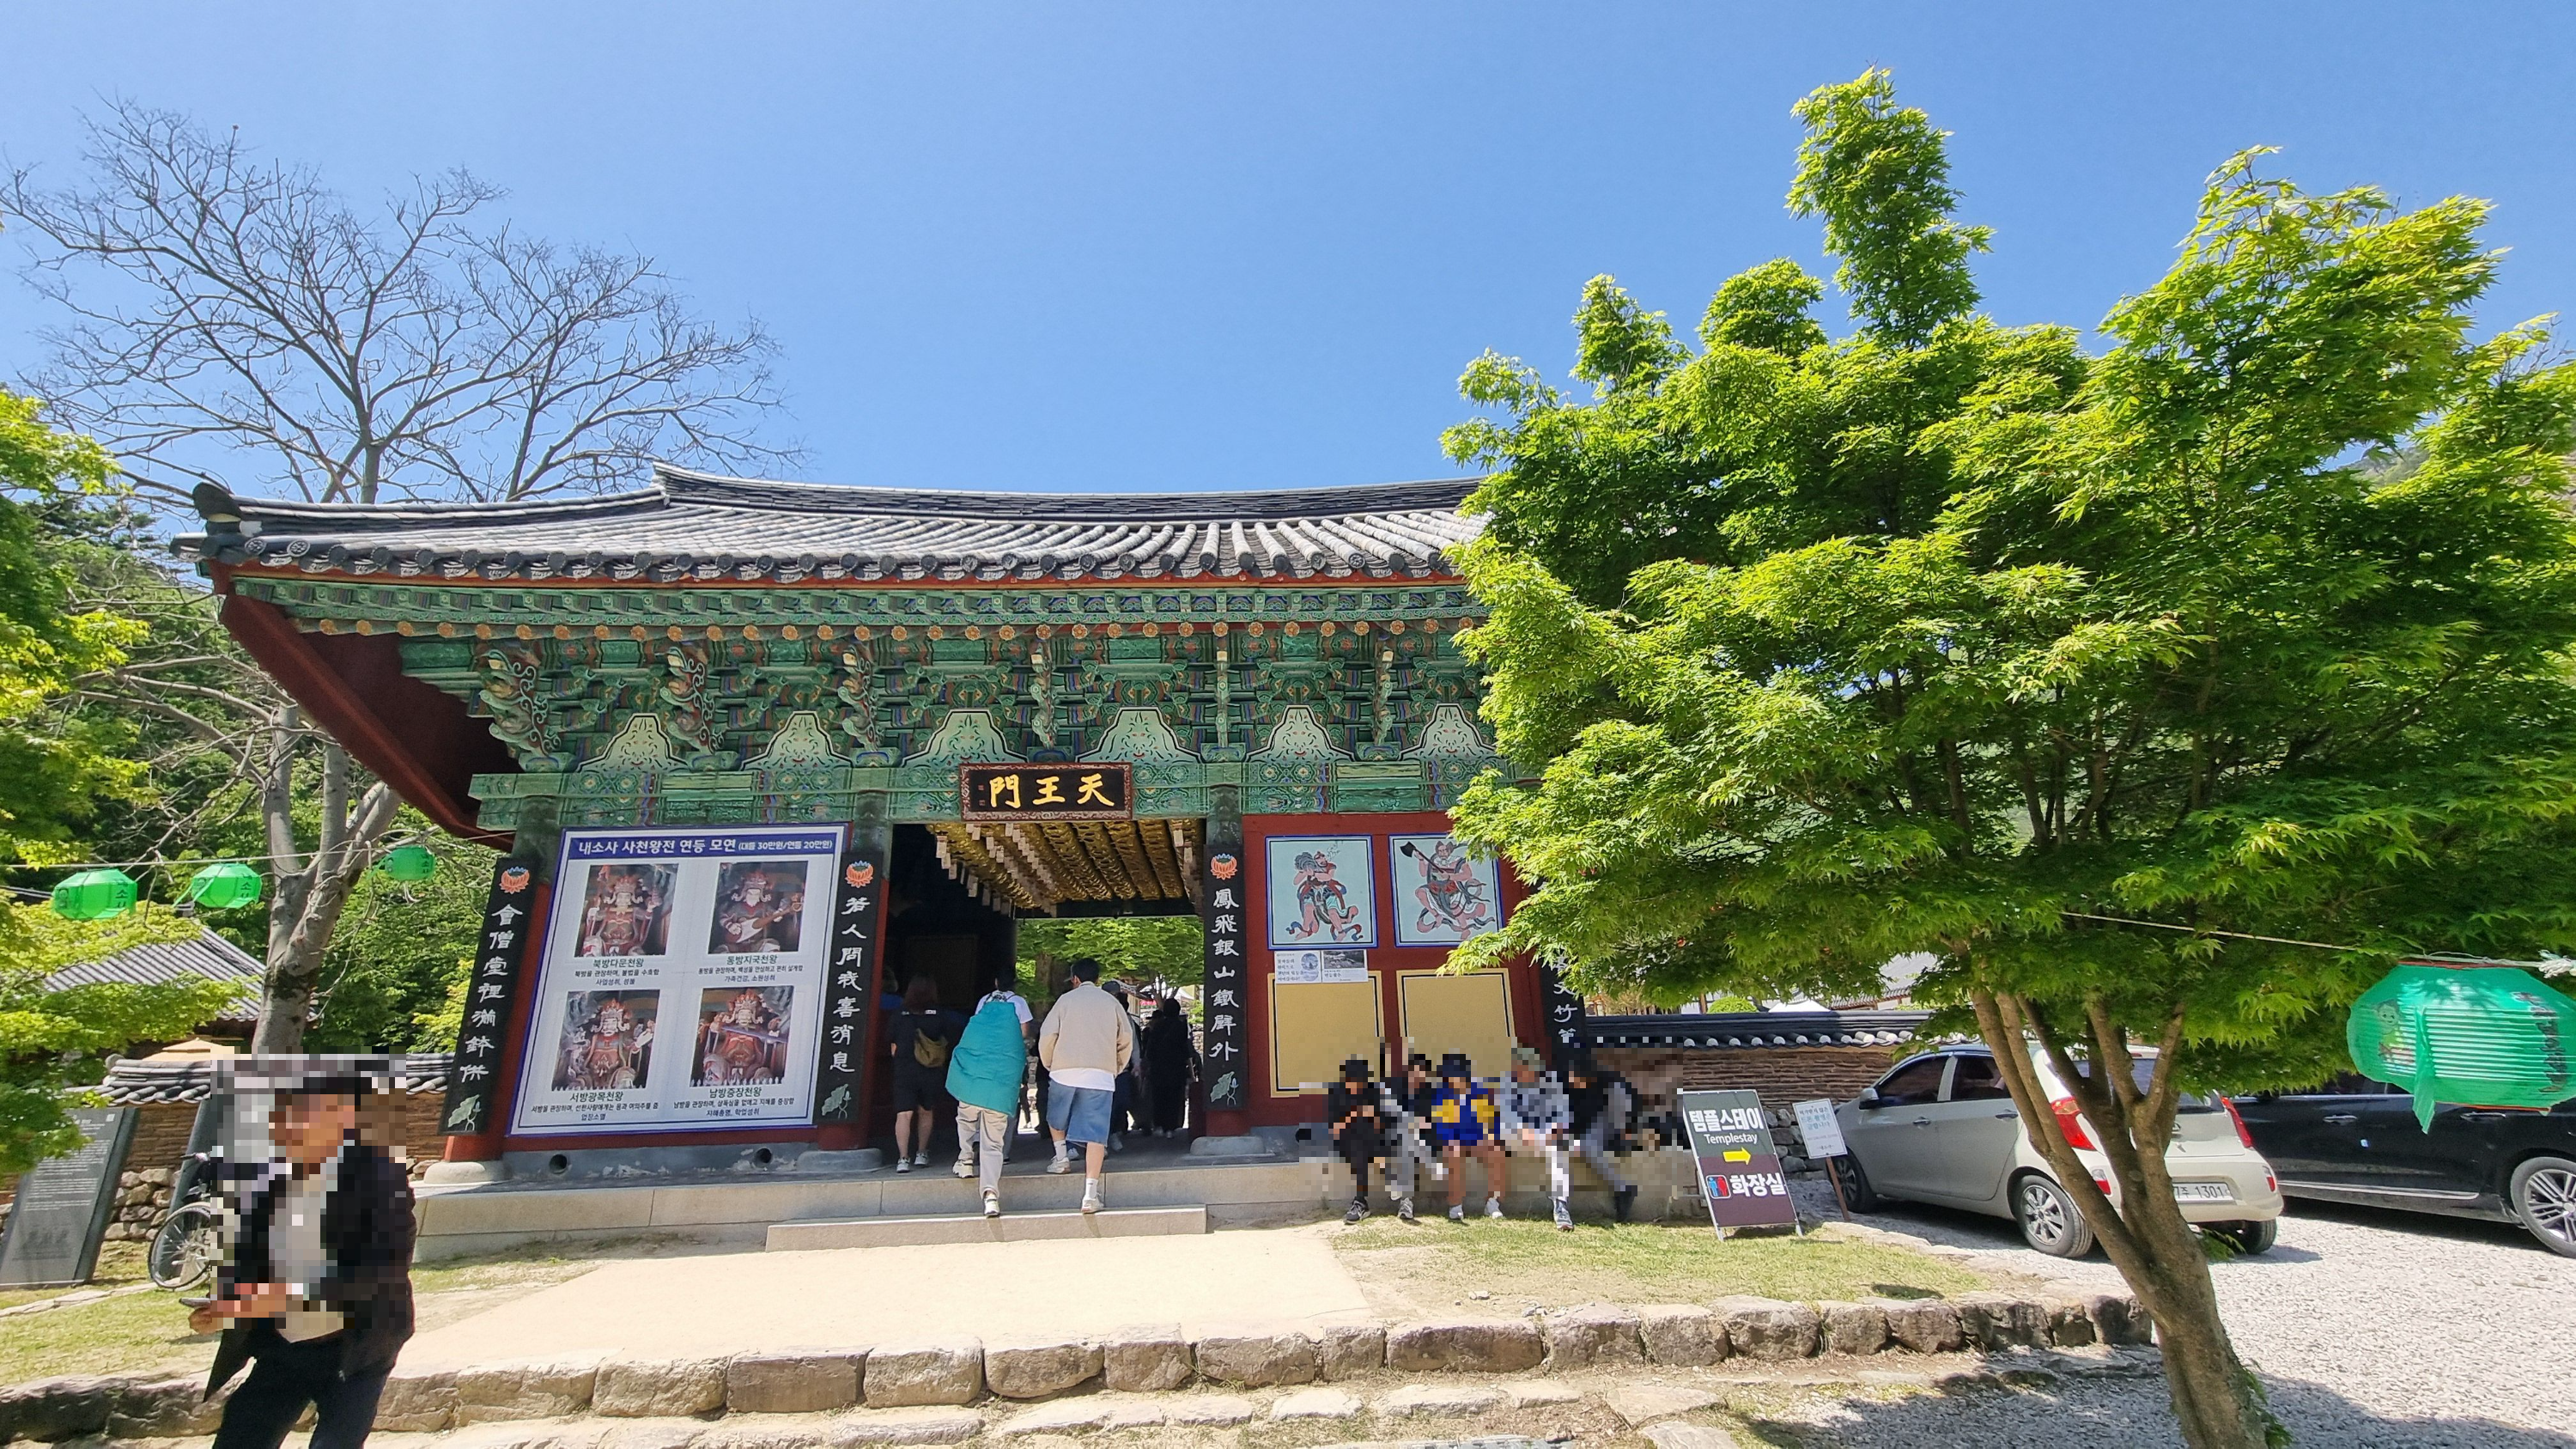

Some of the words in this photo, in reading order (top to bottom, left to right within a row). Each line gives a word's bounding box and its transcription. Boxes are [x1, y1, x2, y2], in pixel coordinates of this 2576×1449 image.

[579, 840, 618, 855] 내소사
[622, 839, 676, 855] 사천왕전
[679, 839, 706, 853] 연등
[709, 838, 736, 852] 모연
[592, 958, 645, 969] 북방다문천왕
[726, 954, 778, 965] 동방지국천왕
[570, 1091, 624, 1102] 서방광목천왕
[709, 1087, 762, 1099] 남방증장천왕
[1688, 1107, 1765, 1133] 템플스테이
[1704, 1133, 1758, 1146] Templestay
[1729, 1172, 1787, 1197] 화장실
[2195, 1185, 2225, 1199] 1301
